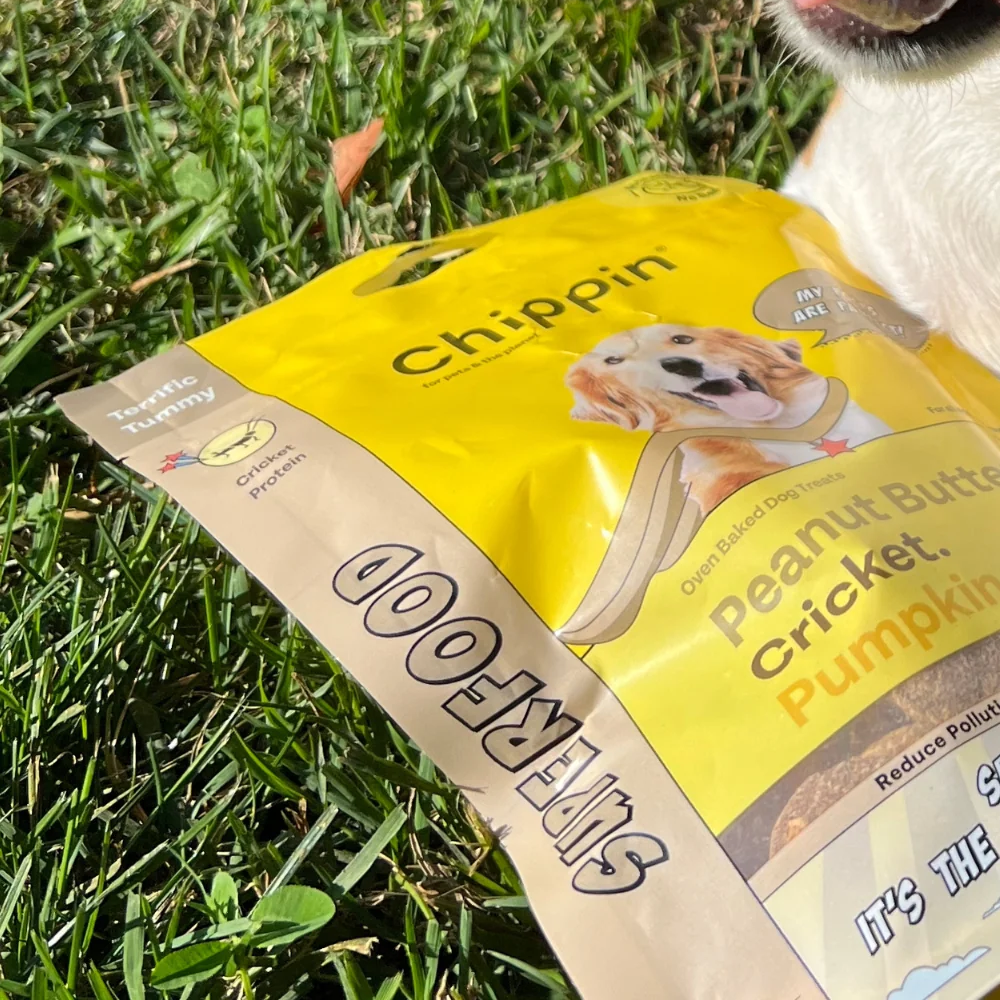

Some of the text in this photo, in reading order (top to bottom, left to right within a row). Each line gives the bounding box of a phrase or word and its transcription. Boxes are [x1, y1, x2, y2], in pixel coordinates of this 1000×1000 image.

[792, 302, 829, 324] ARE
[794, 286, 823, 304] MY
[107, 375, 199, 421] Terrific
[120, 386, 216, 434] Tummy
[236, 444, 296, 487] Cricket
[248, 453, 308, 500] Protein
[681, 471, 846, 596] Oven Baked Dog Treats
[708, 494, 891, 649] Peanut
[750, 531, 951, 680] Cricket.
[332, 543, 670, 895] SUPERFOOD
[874, 737, 947, 791] Reduce
[855, 877, 926, 956] IT'S
[928, 823, 1000, 897] THE
